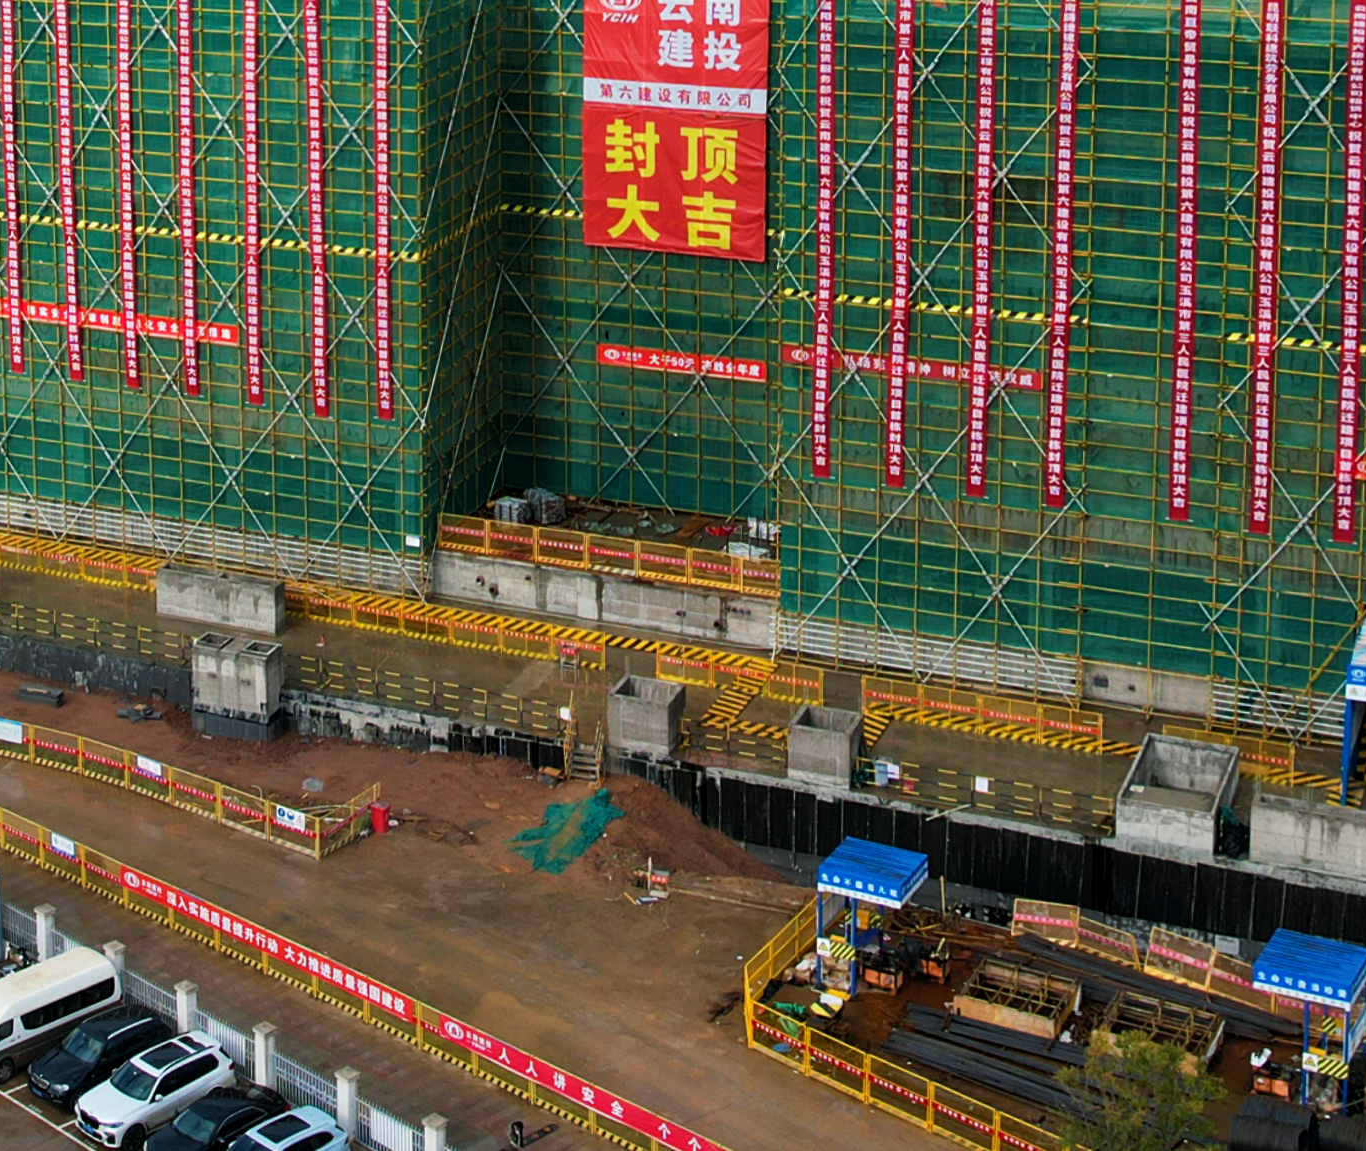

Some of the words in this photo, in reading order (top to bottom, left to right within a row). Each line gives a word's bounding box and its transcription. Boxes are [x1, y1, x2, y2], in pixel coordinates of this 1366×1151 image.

[601, 11, 638, 23] YCIH
[657, 28, 742, 72] 建投
[599, 83, 753, 110] 第六建设有限公司
[605, 119, 739, 186] 封顶
[606, 185, 737, 251] 大吉
[166, 890, 279, 954] 深入实施质量提升行动
[284, 945, 406, 1015] 大力推进质量强国建设
[499, 1047, 624, 1118] 人人讲安全
